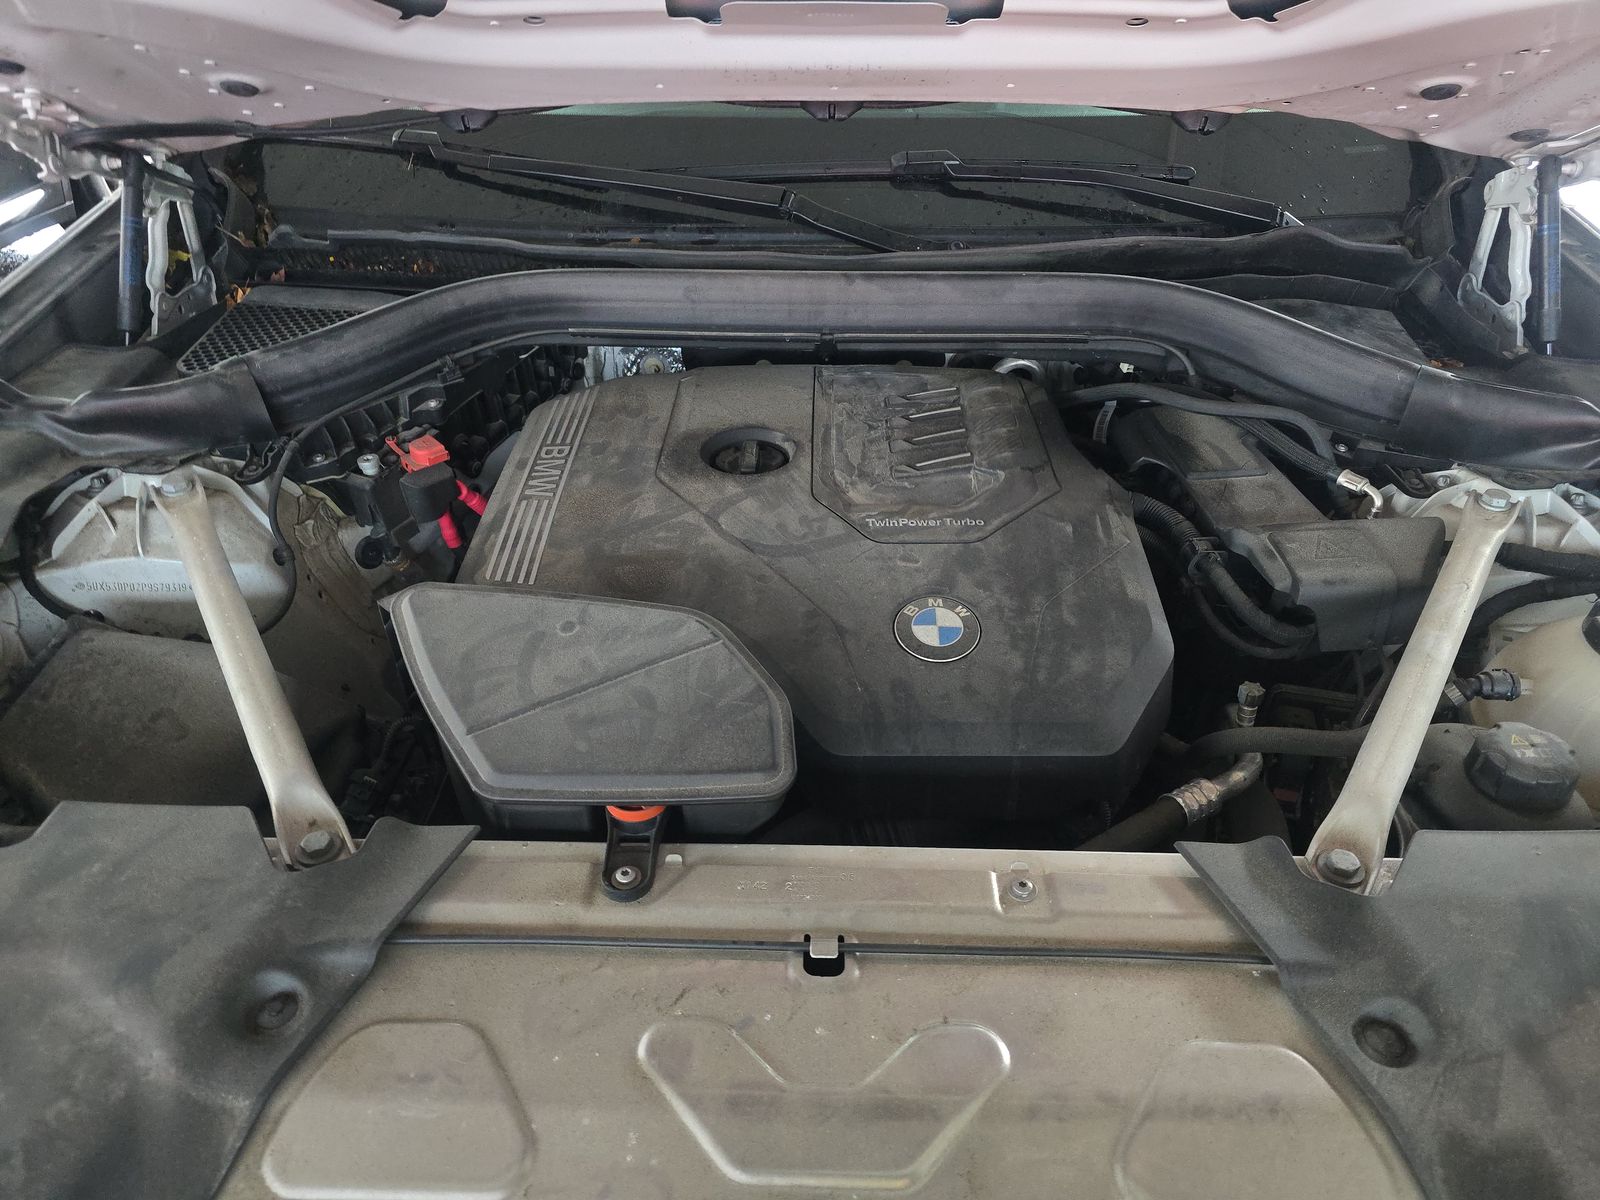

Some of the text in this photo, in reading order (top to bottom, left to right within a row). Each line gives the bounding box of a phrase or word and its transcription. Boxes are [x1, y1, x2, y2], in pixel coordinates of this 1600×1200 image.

[524, 445, 570, 497] BMW
[865, 517, 985, 527] TwinPower Turbo
